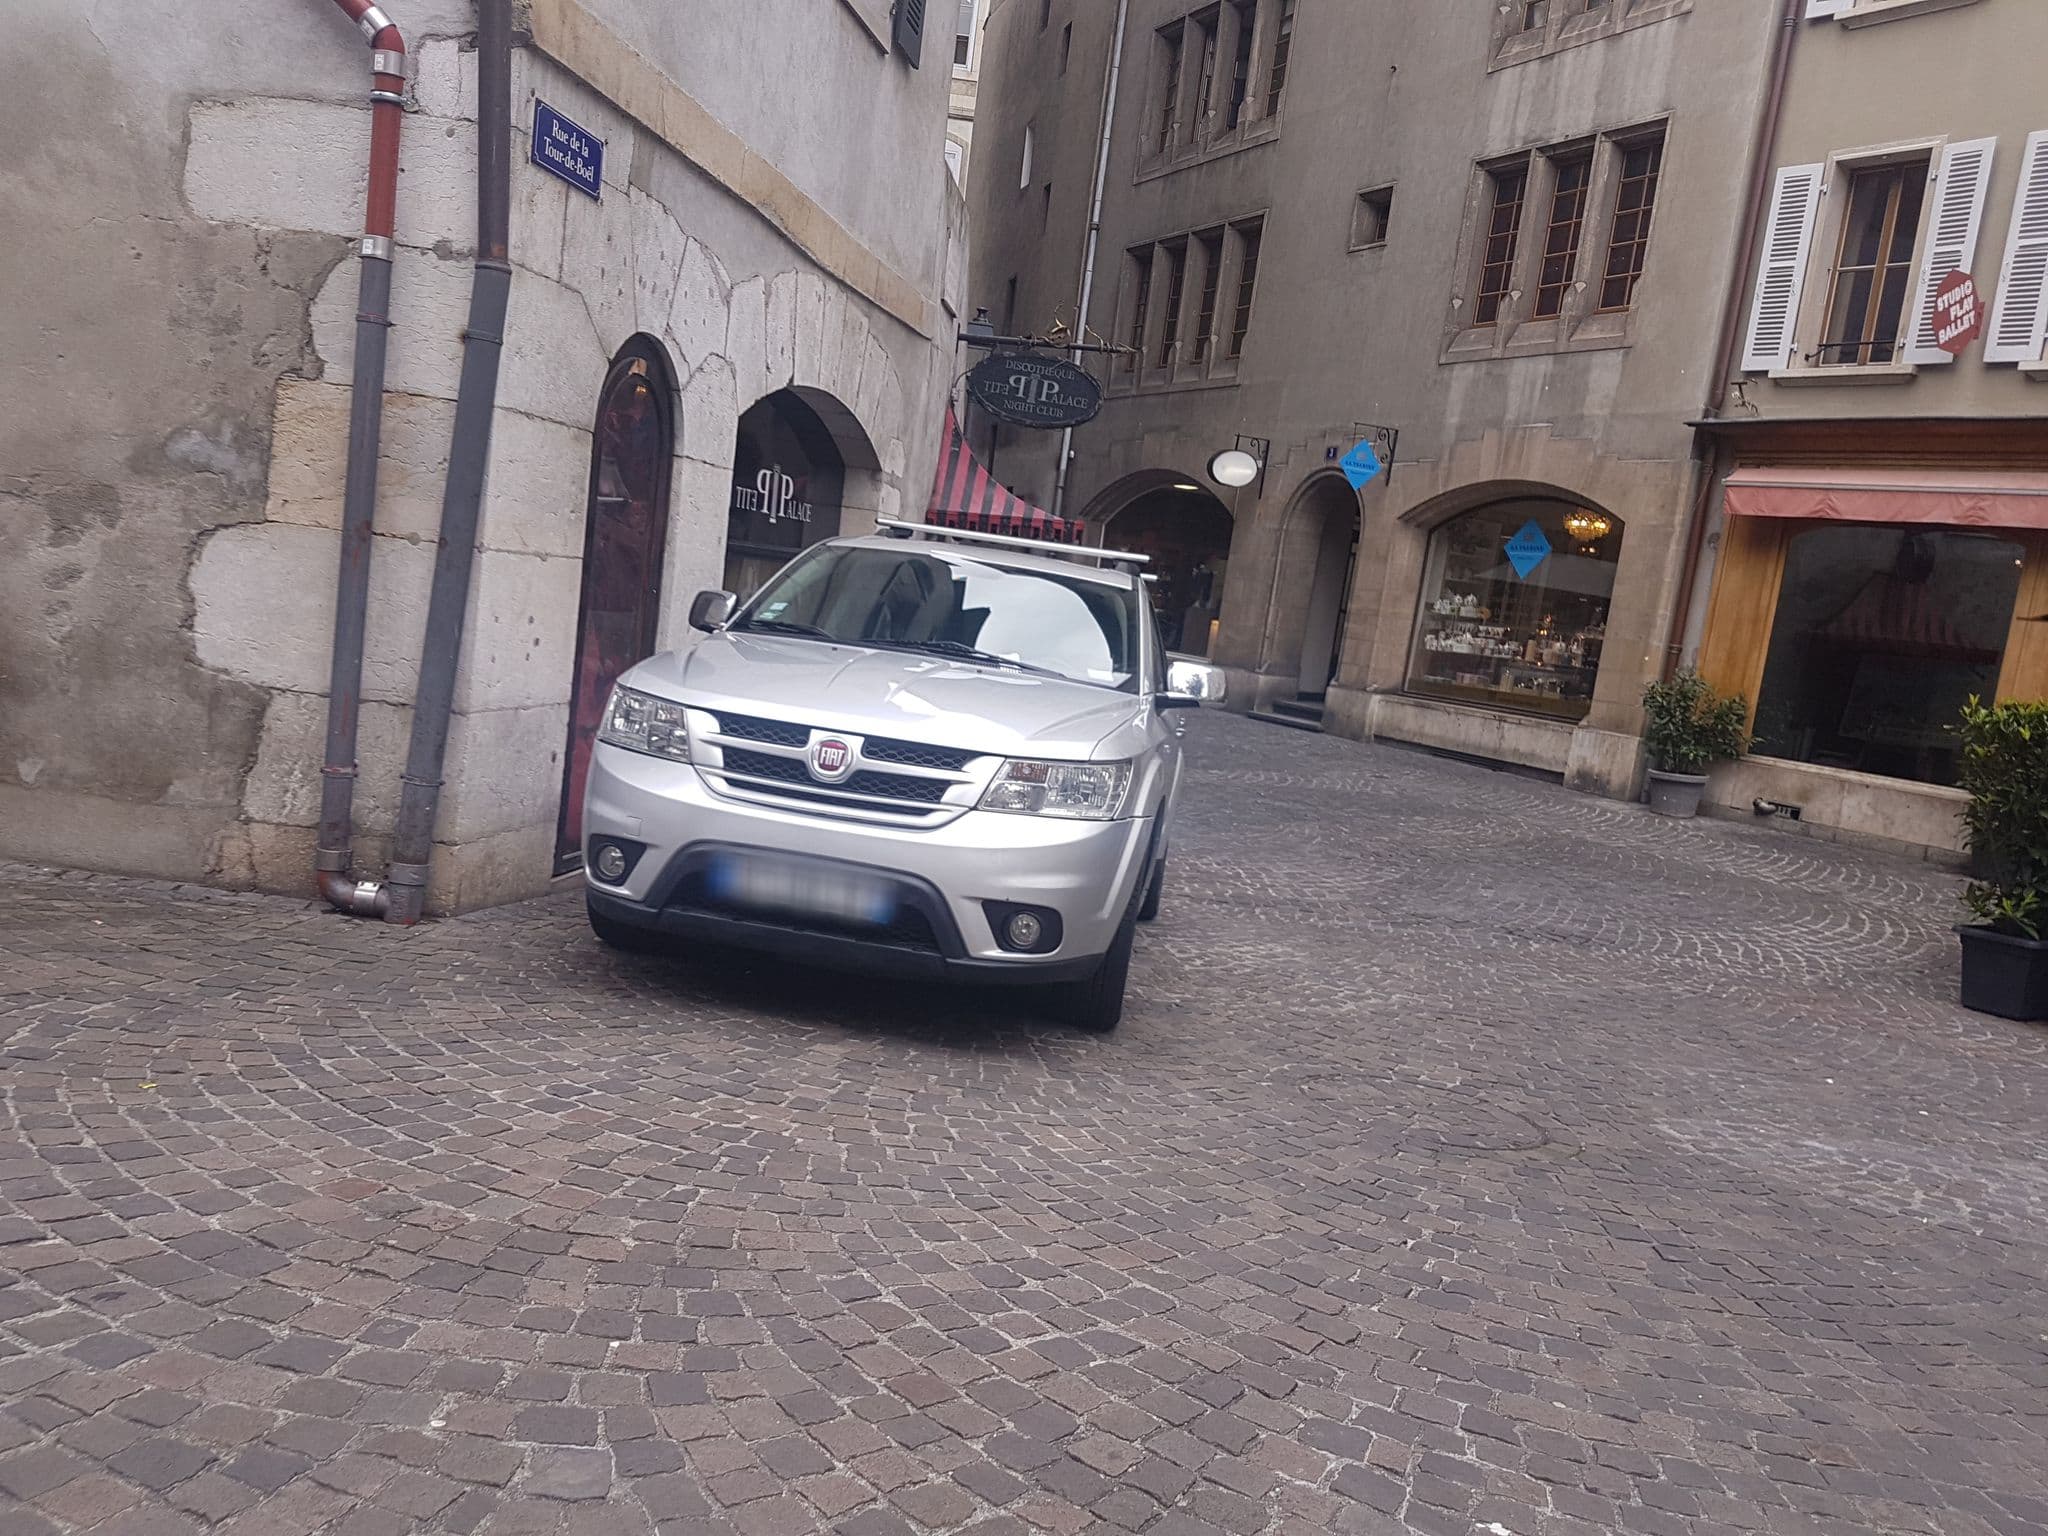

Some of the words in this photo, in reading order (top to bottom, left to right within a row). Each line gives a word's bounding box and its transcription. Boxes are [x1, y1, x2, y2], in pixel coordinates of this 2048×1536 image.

[552, 119, 569, 145] Rue
[569, 132, 580, 152] de
[581, 138, 589, 158] la
[543, 136, 595, 183] Tour-de-Boël
[1936, 279, 1973, 312] STUDIO
[1949, 294, 1974, 322] PLAY
[1938, 310, 1976, 345] BALLET
[1003, 399, 1035, 413] NIGHT
[1036, 404, 1064, 418] CLUB
[1038, 379, 1089, 409] PALACE
[778, 473, 813, 523] PALACE
[820, 746, 845, 767] FIAT
